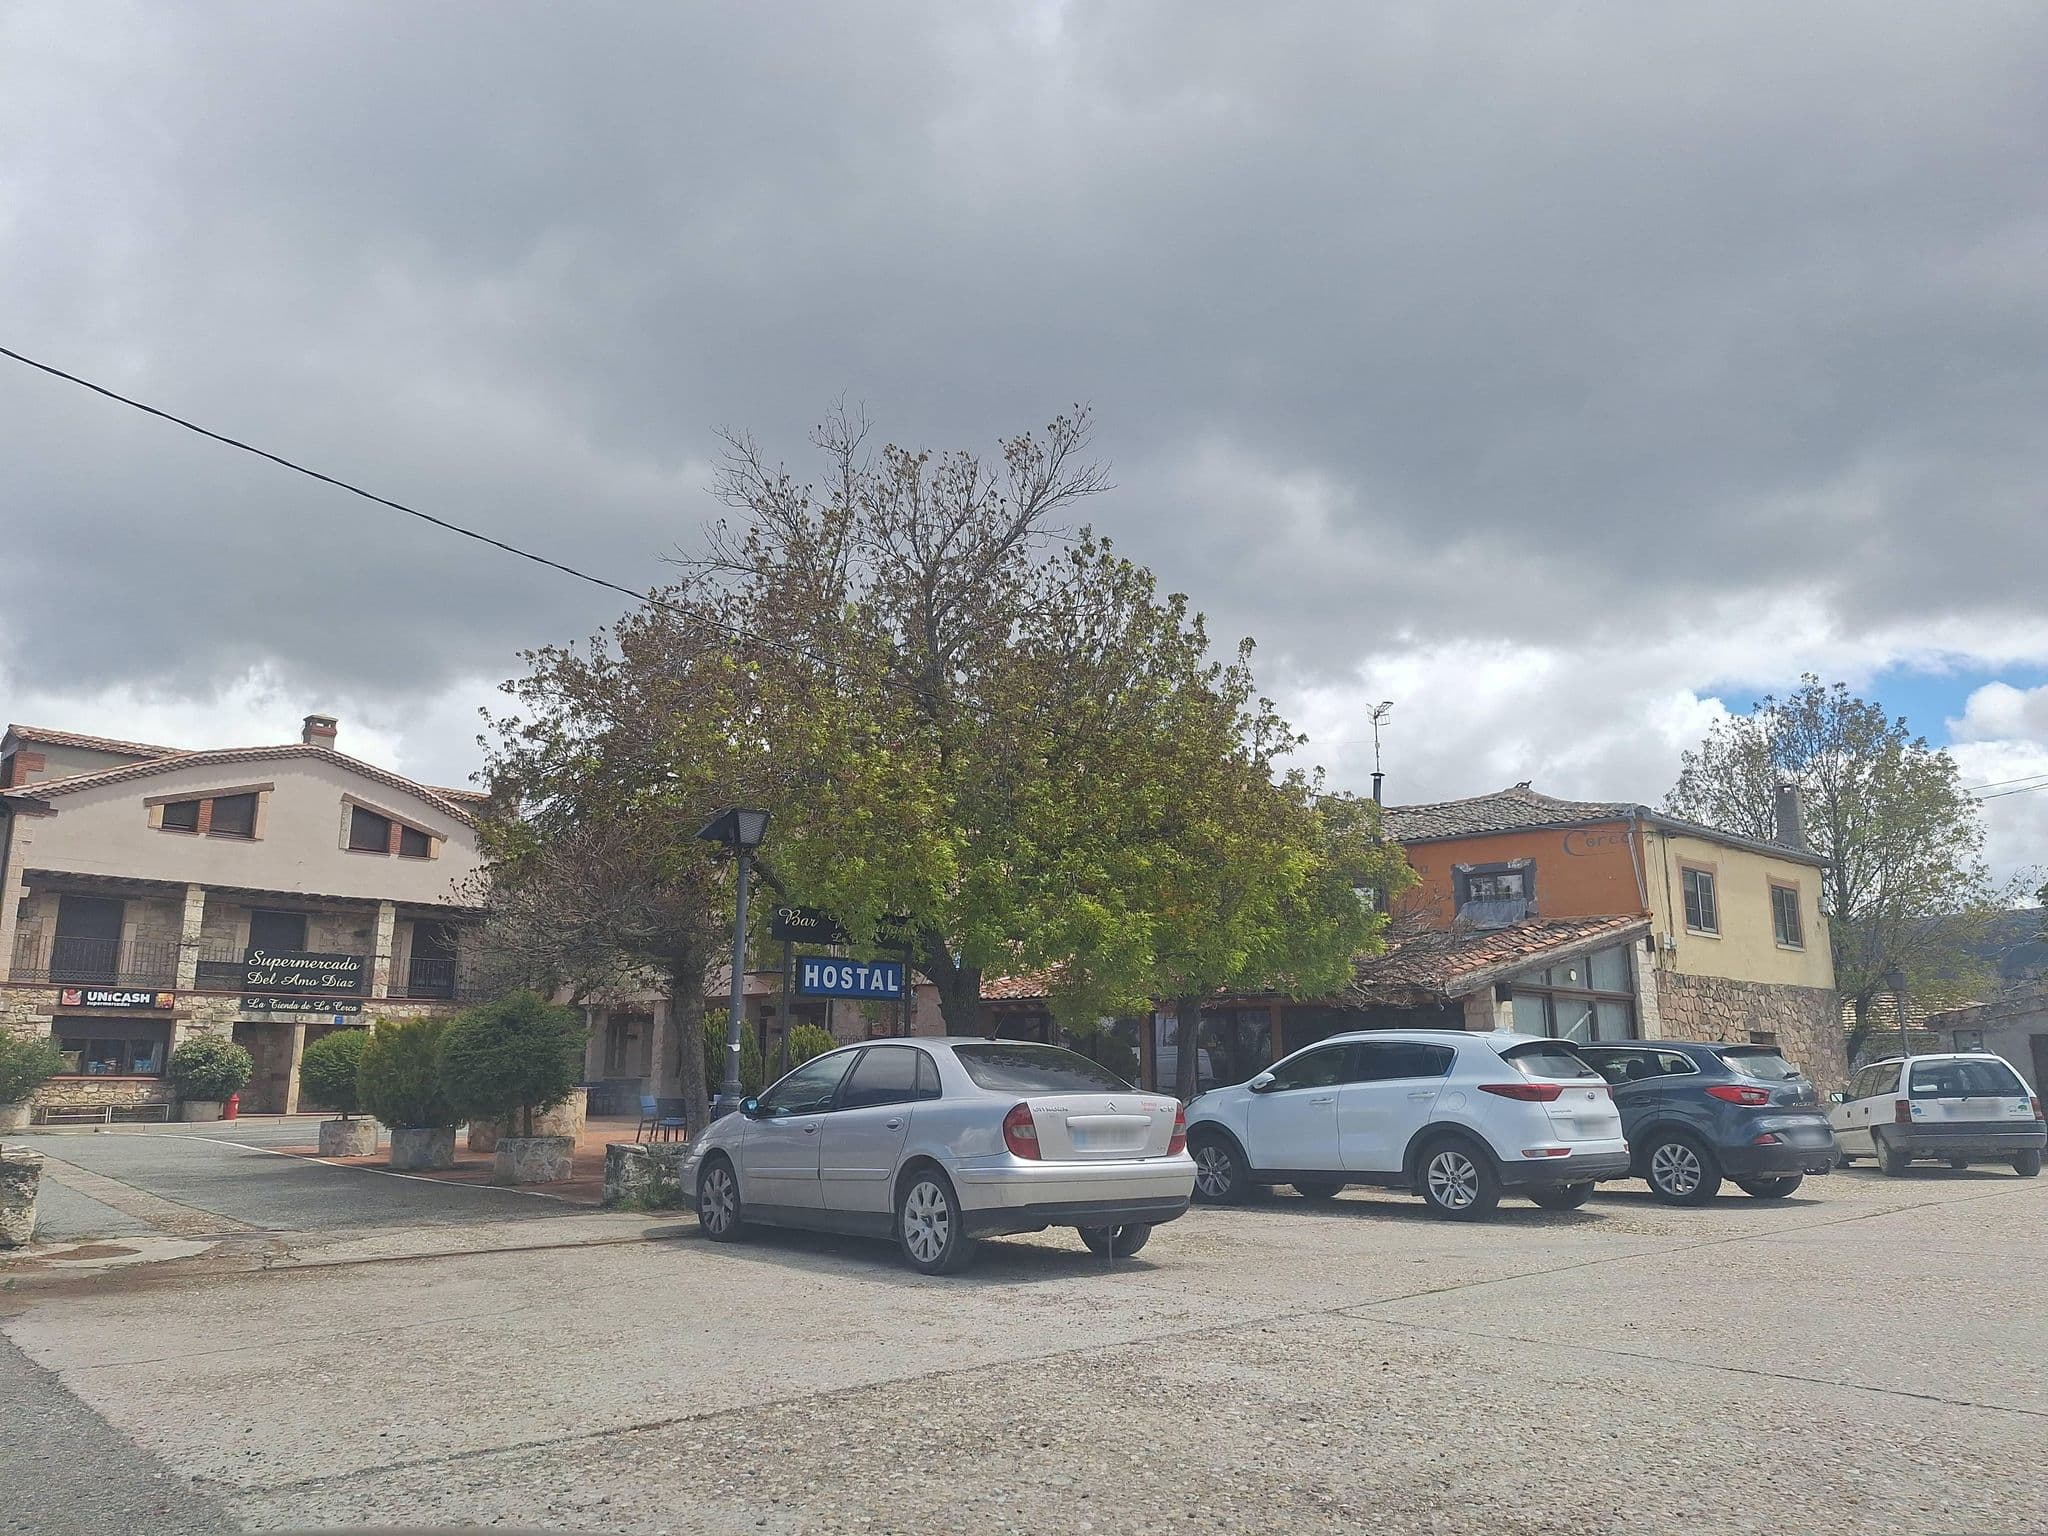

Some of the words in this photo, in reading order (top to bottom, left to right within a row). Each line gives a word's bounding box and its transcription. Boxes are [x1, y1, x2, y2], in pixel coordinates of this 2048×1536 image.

[778, 908, 819, 928] Bar
[248, 950, 360, 972] Supermercado
[247, 971, 277, 985] Del
[281, 973, 318, 986] Amo
[804, 964, 898, 992] HOSTAL
[247, 998, 266, 1009] La
[269, 998, 299, 1010] Tienda
[300, 1001, 312, 1010] de
[314, 1001, 331, 1011] La
[333, 1001, 358, 1013] Cerca
